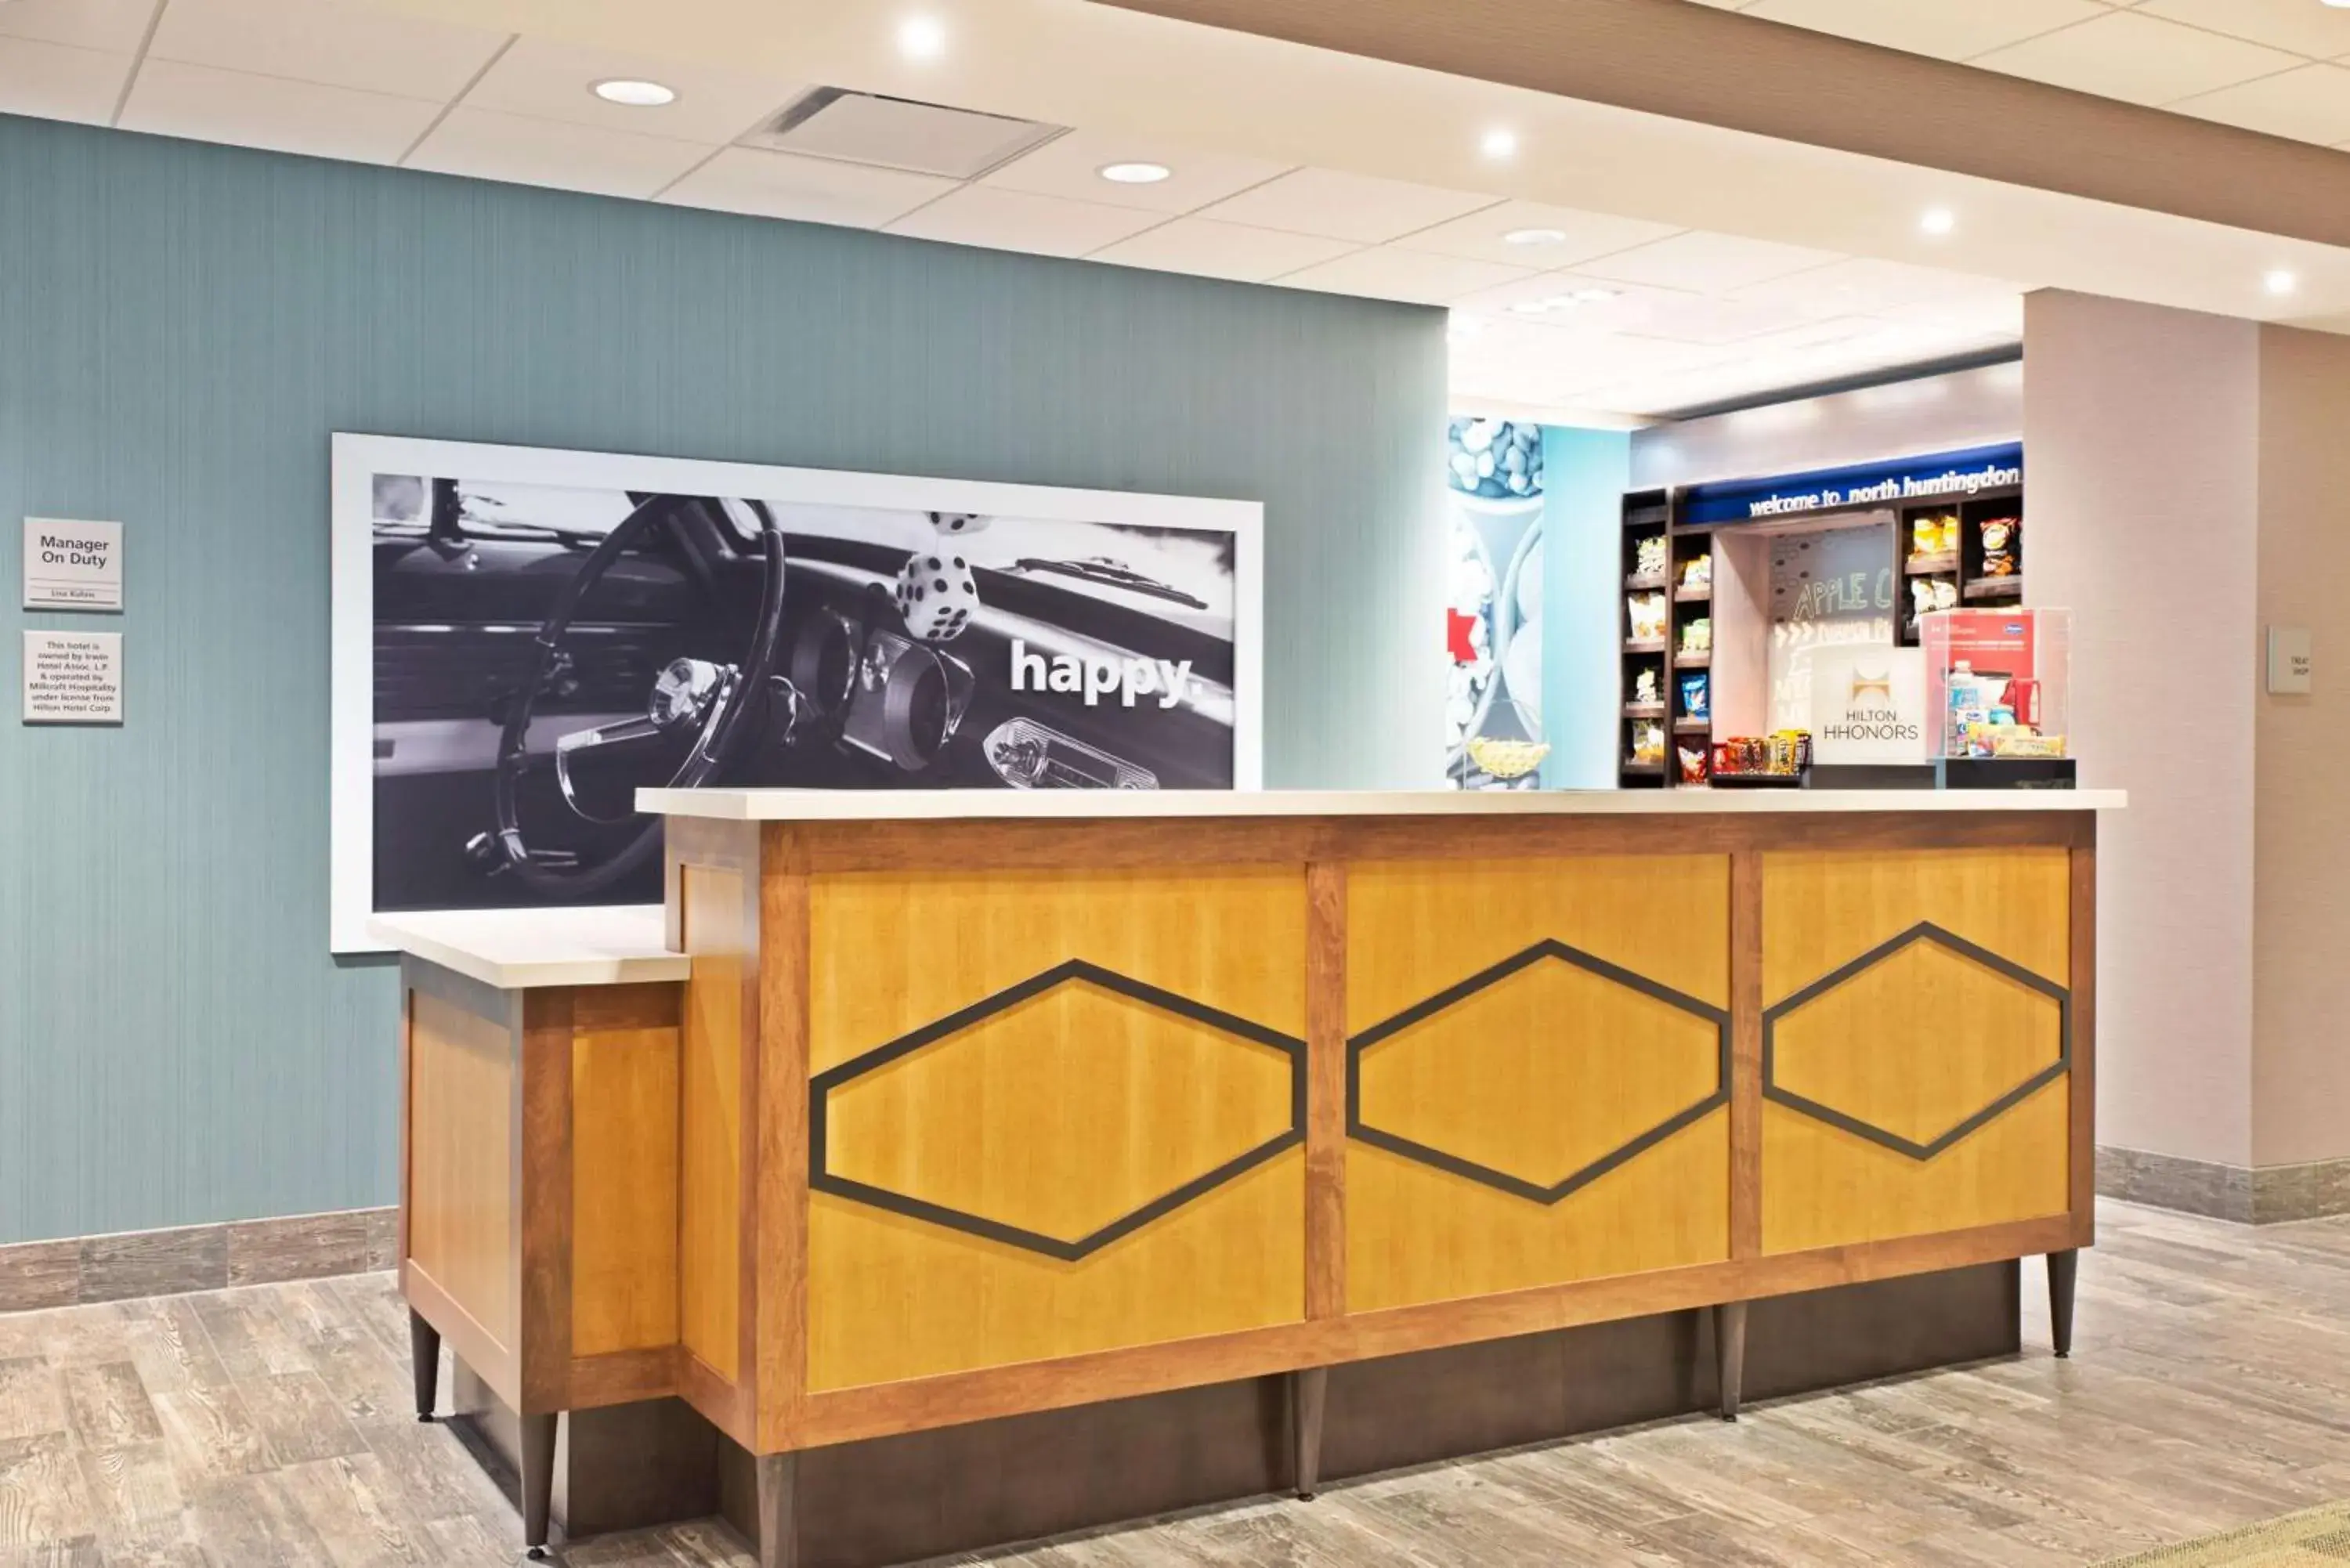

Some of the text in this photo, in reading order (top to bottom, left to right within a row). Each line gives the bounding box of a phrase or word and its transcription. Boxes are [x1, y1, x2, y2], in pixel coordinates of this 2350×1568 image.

[1749, 464, 2019, 517] welcome to north huntingdon
[40, 535, 110, 553] Manager
[42, 551, 107, 569] On Duty
[1792, 571, 1869, 620] APPLE
[46, 641, 65, 649] This
[67, 641, 90, 649] hotel
[71, 652, 82, 662] by
[37, 660, 62, 670] Hotel
[50, 673, 91, 682] operated
[68, 682, 117, 694] Hospitality
[31, 693, 59, 702] under
[92, 693, 115, 702] from
[33, 703, 61, 712] Hilton
[1846, 710, 1896, 721] HILTON
[1824, 724, 1918, 740] HHONORS
